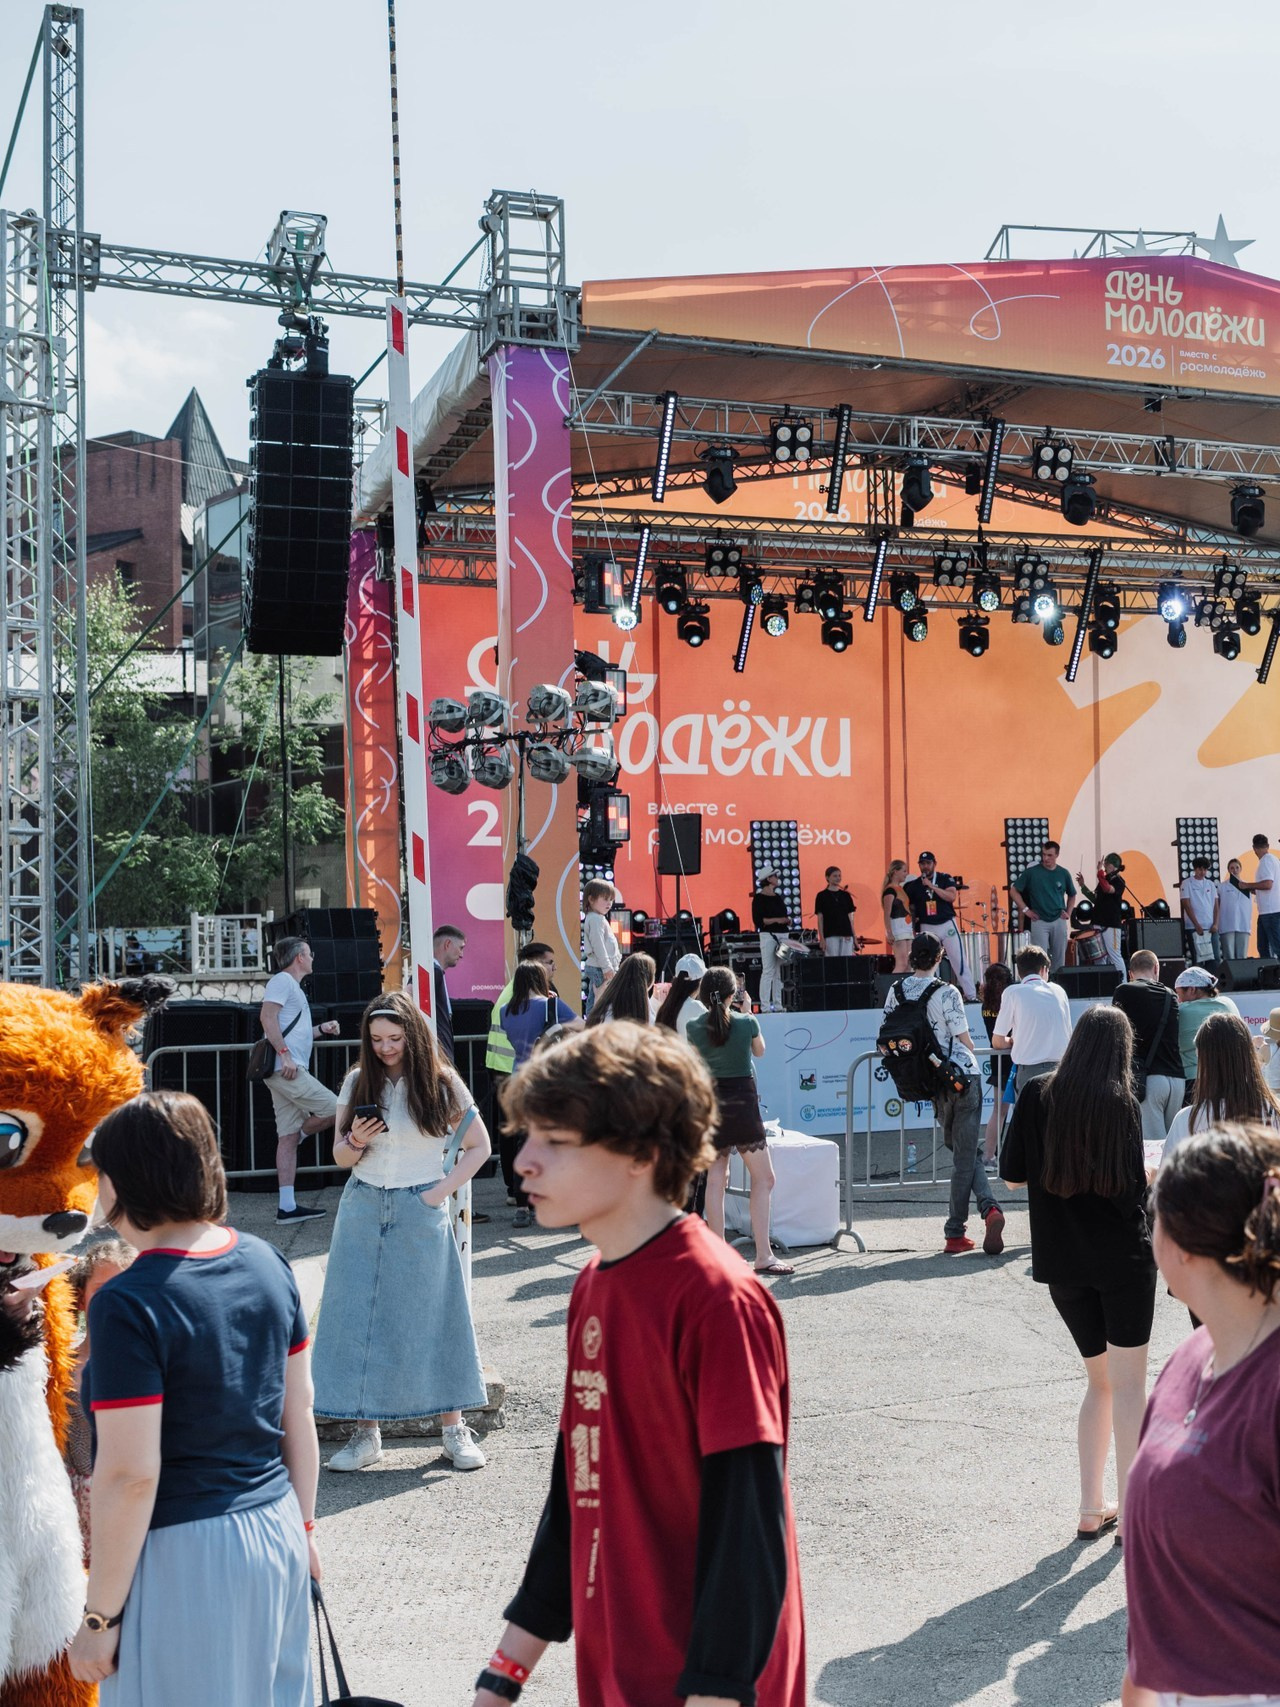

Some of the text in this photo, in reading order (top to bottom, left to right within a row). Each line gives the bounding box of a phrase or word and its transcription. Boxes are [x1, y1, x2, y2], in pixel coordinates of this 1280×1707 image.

[1106, 343, 1166, 369] 2026
[1180, 350, 1210, 360] вместе
[1180, 362, 1266, 379] росмолодёжь
[648, 803, 736, 816] вместе с
[648, 824, 851, 854] рмоёжь
